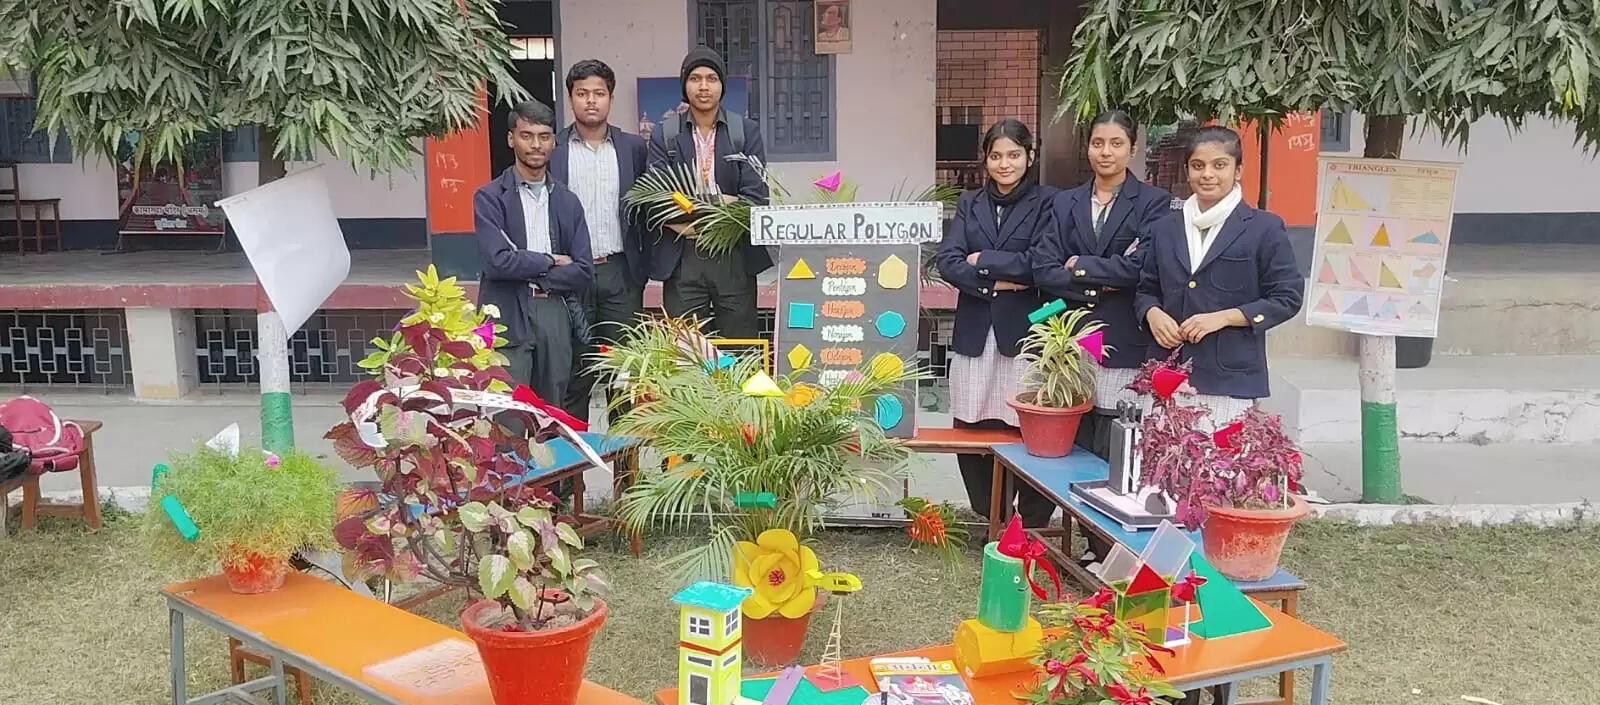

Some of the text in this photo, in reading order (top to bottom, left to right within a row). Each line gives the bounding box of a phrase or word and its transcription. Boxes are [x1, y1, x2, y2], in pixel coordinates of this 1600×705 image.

[1347, 163, 1397, 173] TRIANGLES
[760, 212, 932, 241] REGULAR POLYGON
